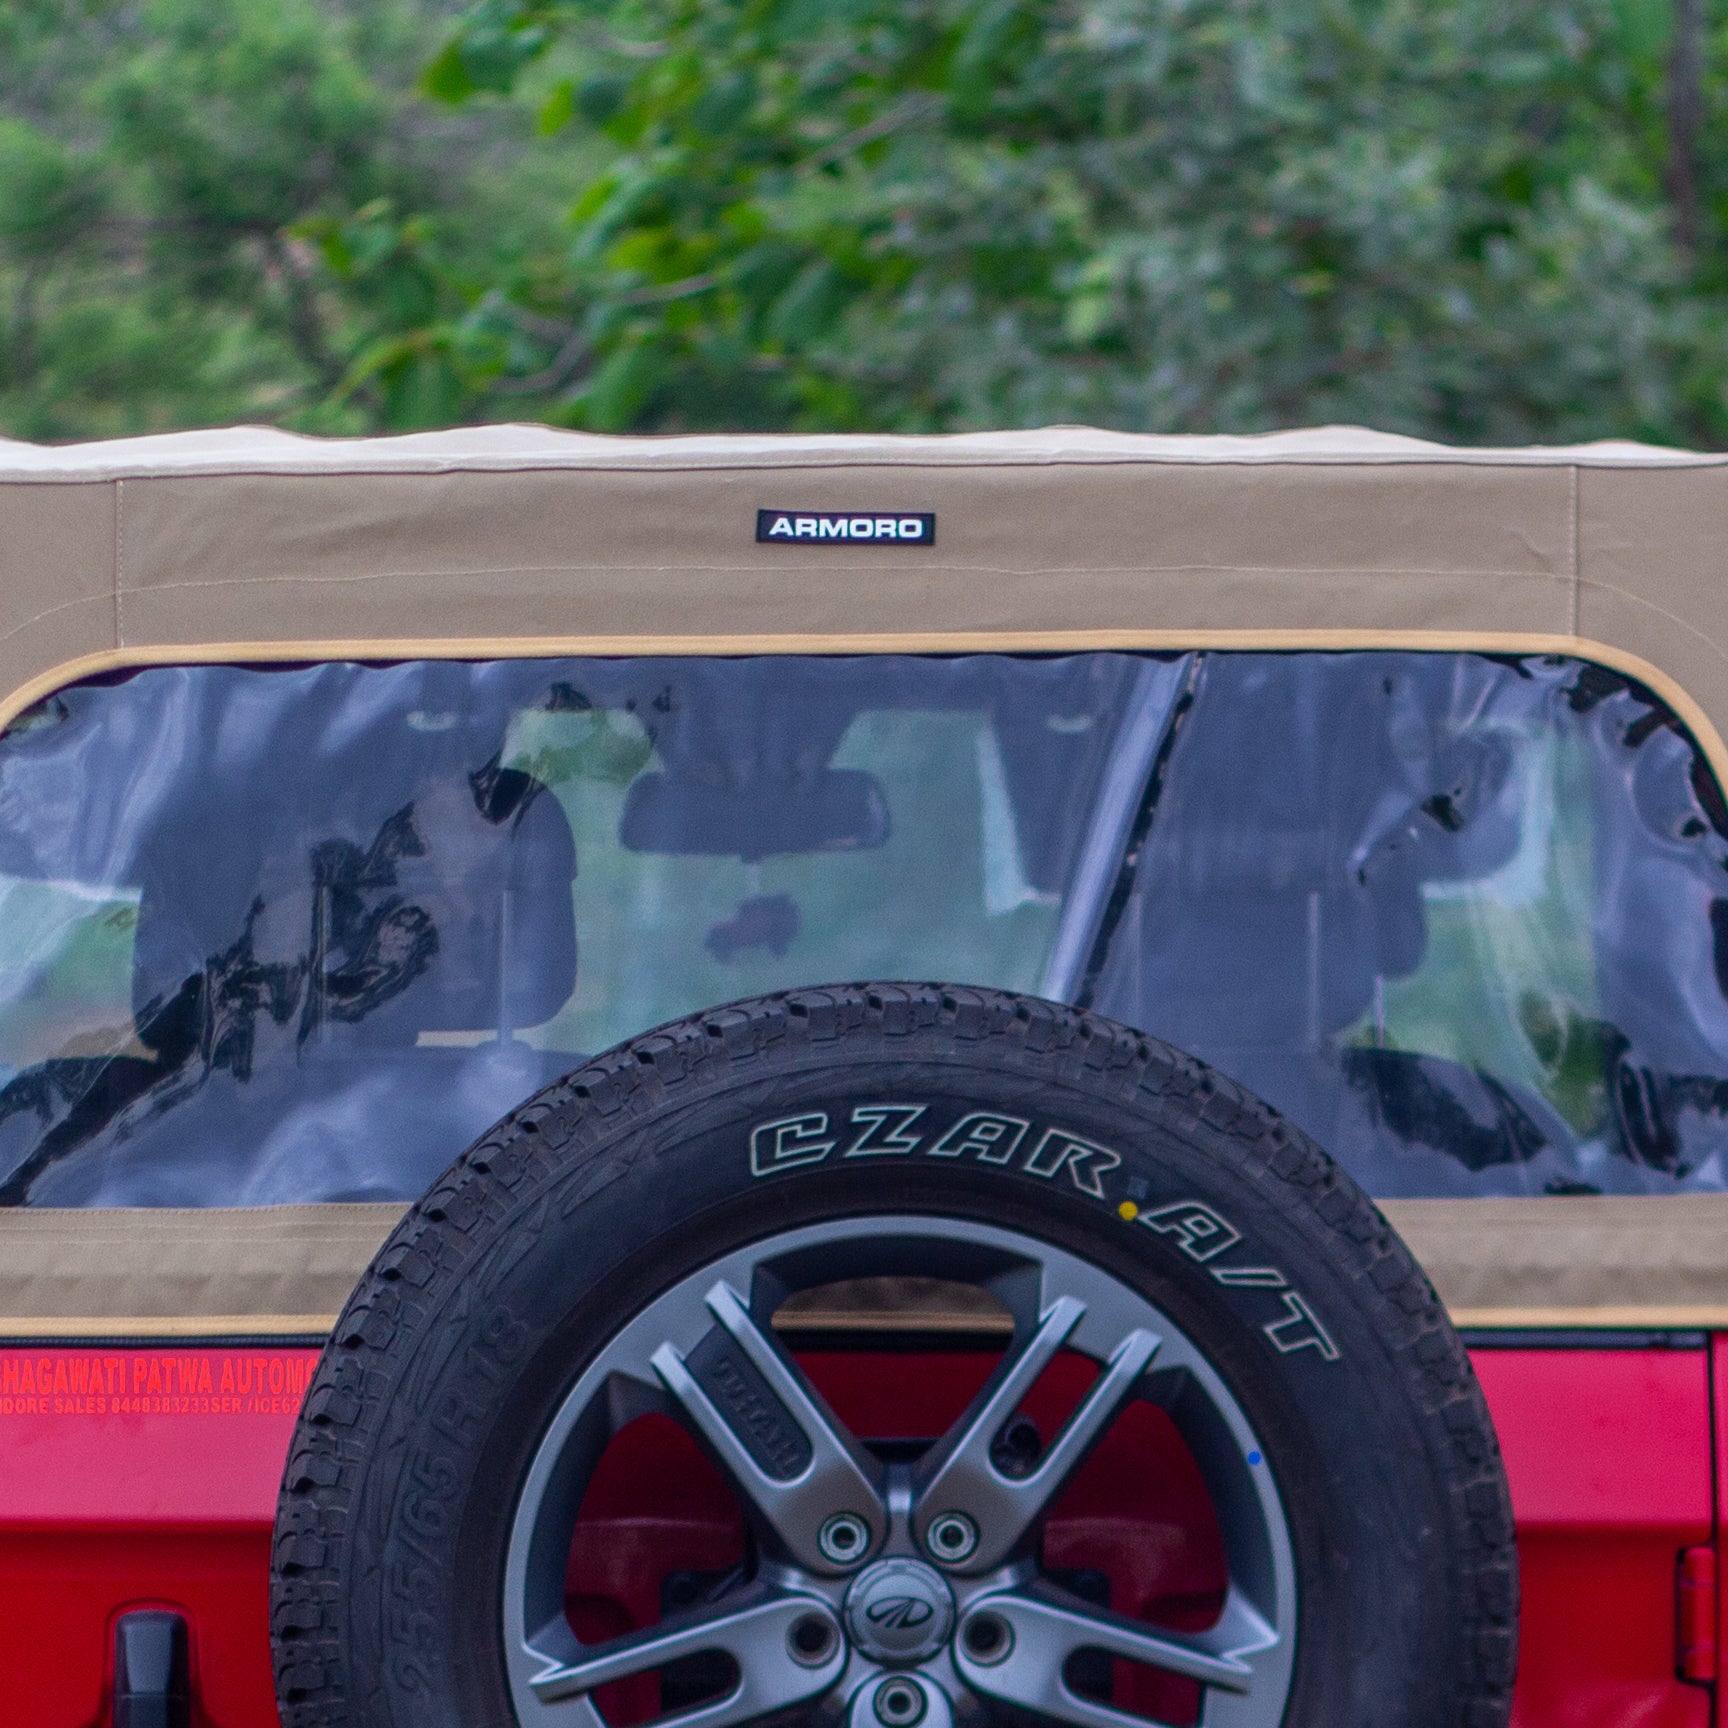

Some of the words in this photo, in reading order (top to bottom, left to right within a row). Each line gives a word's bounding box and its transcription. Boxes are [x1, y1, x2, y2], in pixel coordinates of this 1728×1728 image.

[768, 517, 924, 539] ARMORO
[750, 1103, 1122, 1200] CZAR
[1137, 1200, 1341, 1362] A/T
[134, 1358, 212, 1395] PATWA
[54, 1397, 106, 1415] SALES
